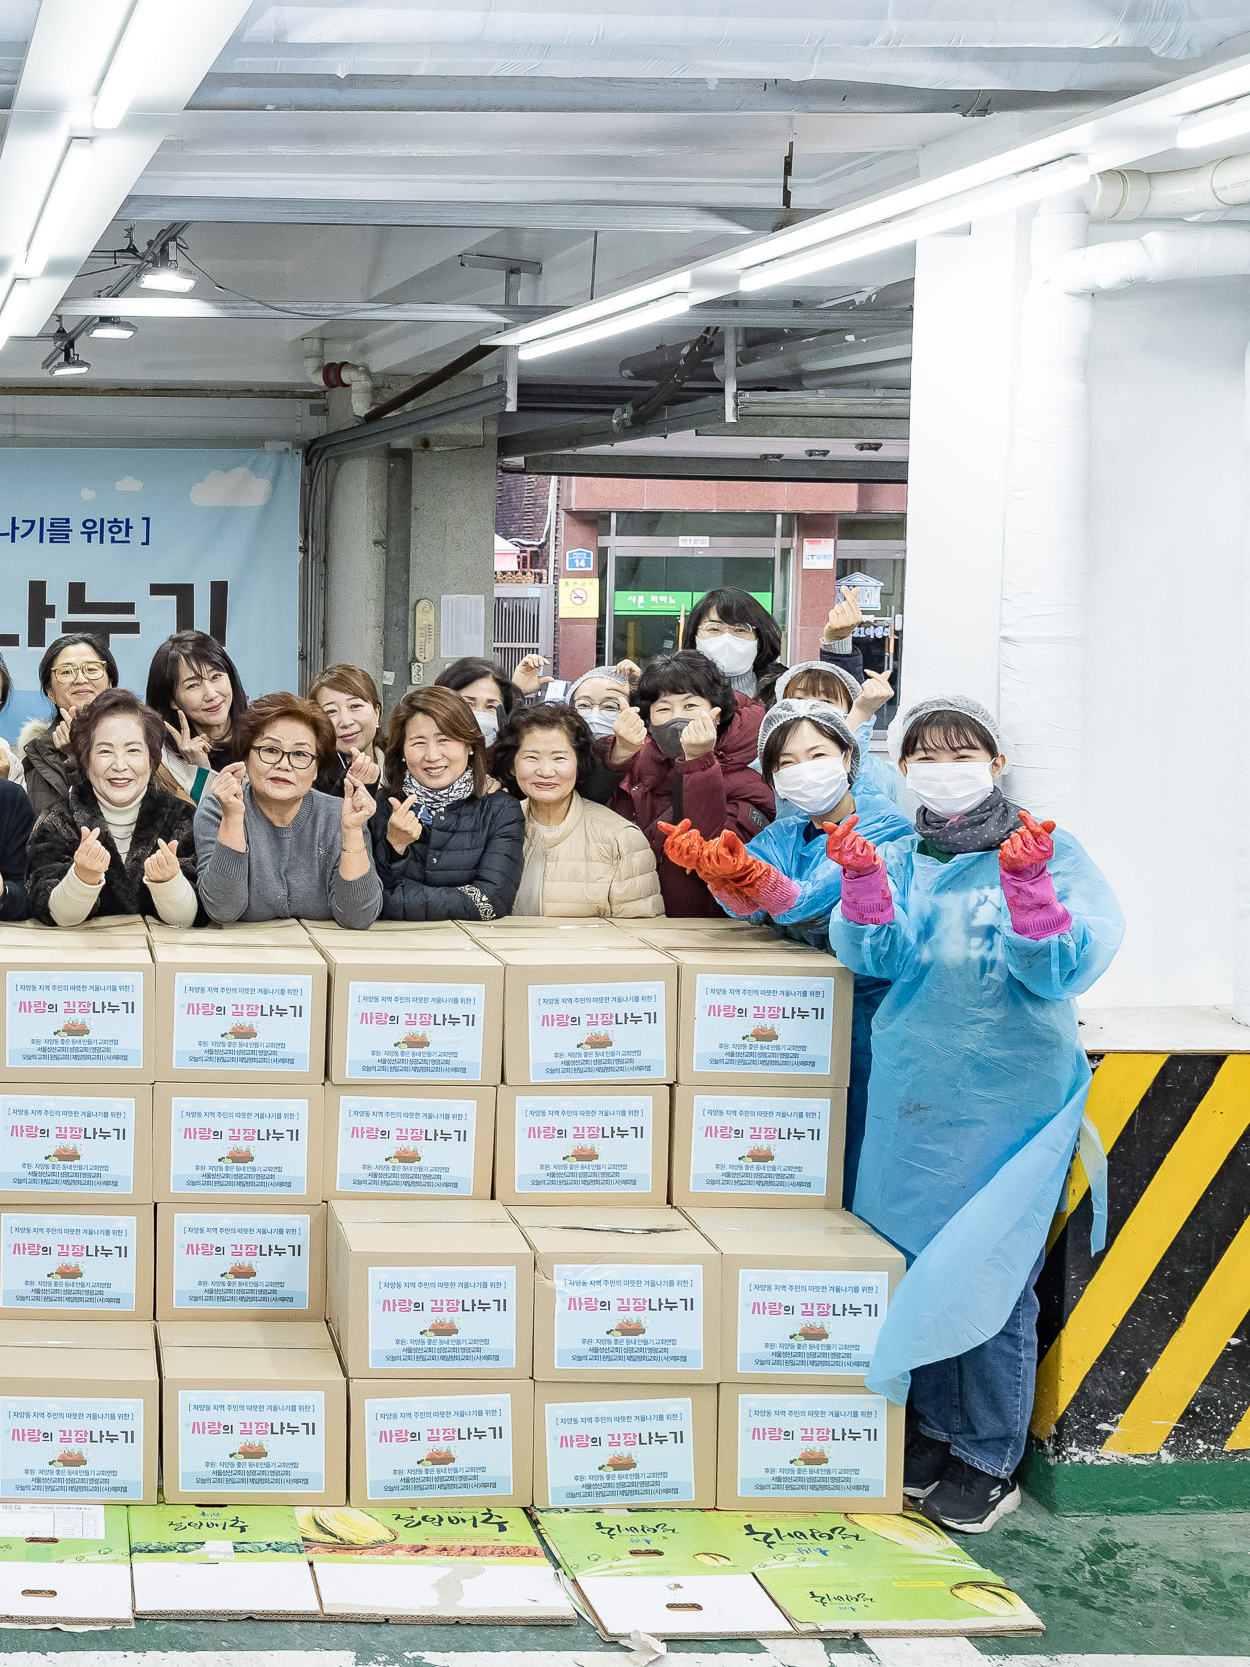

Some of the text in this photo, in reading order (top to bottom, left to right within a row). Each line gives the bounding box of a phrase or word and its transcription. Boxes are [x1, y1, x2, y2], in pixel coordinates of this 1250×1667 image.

[80, 516, 133, 545] 위한
[574, 559, 586, 568] 14
[18, 1000, 134, 1013] 사랑의 김장나누기
[186, 1002, 302, 1017] 사랑의 김장나누기
[707, 1004, 824, 1020] 사랑의 김장나누기
[541, 1012, 656, 1027] 사랑의 김장나누기
[10, 1125, 125, 1140] 사랑의 김장나누기
[350, 1126, 466, 1142] 사랑의 김장나누기
[527, 1126, 643, 1138] 사랑의 김장나누기
[186, 1243, 300, 1256] 사랑의 김장나누기
[382, 1299, 506, 1312] 사랑의 김장나누기
[751, 1301, 877, 1317] 사랑의 김장나누기
[85, 1412, 115, 1420] 겨울나기를
[11, 1428, 133, 1443] 사랑의 김장나누기
[191, 1421, 315, 1435] 사랑의 김장나누기
[378, 1426, 502, 1443] 사랑의 김장나누기
[751, 1427, 877, 1441] 사랑의 김장나누기
[167, 1516, 250, 1533] 절임배추
[391, 1507, 508, 1532] 절임배추
[743, 1524, 866, 1549] 절임배추
